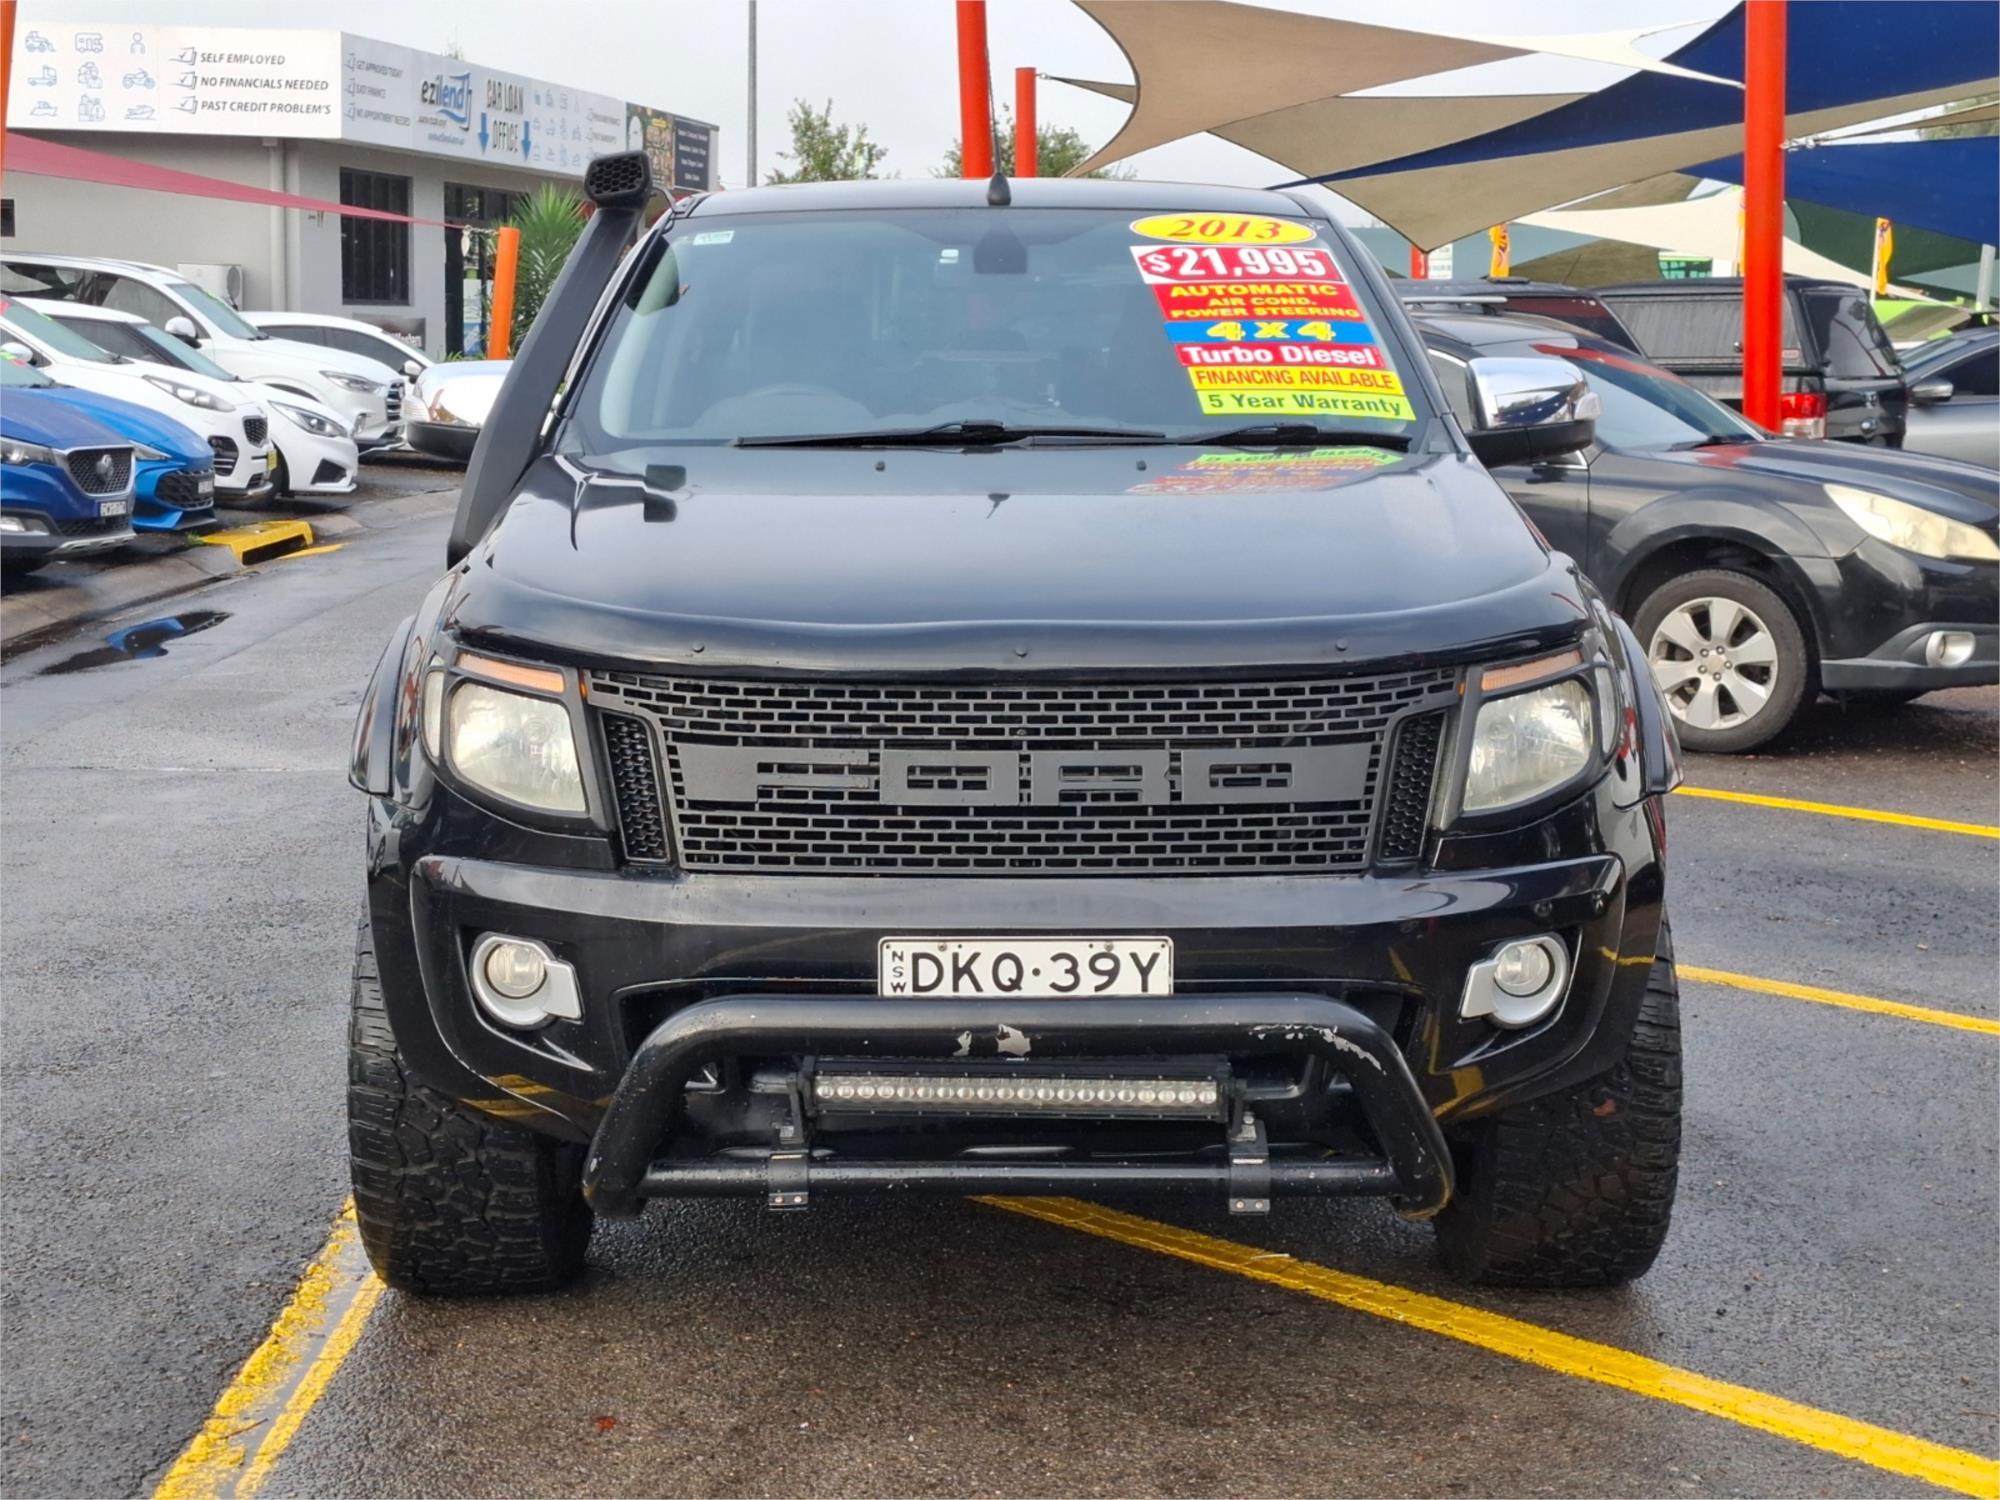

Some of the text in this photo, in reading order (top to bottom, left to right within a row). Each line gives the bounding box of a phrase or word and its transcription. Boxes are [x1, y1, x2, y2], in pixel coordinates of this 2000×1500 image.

[200, 52, 286, 65] SELF EMPLOYED
[200, 77, 329, 91] NO FINANCIALS NEEDED
[420, 74, 466, 110] ezilend
[486, 79, 524, 115] CAR LOAN
[200, 100, 331, 115] PAST CREDIT PROBLEM'S
[492, 119, 519, 153] OFFICE
[1169, 218, 1283, 240] 2013
[1144, 247, 1327, 279] $21,995
[1170, 284, 1339, 299] AUTOMATIC
[1209, 297, 1318, 306] AIR COND.
[1170, 307, 1360, 319] POWER STEERING
[1205, 321, 1246, 341] 4
[1297, 321, 1337, 341] 4
[1181, 346, 1376, 366] Turbo Diesel
[1195, 370, 1396, 390] FINANCING AVAILABLE
[1209, 393, 1402, 416] 5 Year Warranty
[677, 742, 1371, 806] FORD
